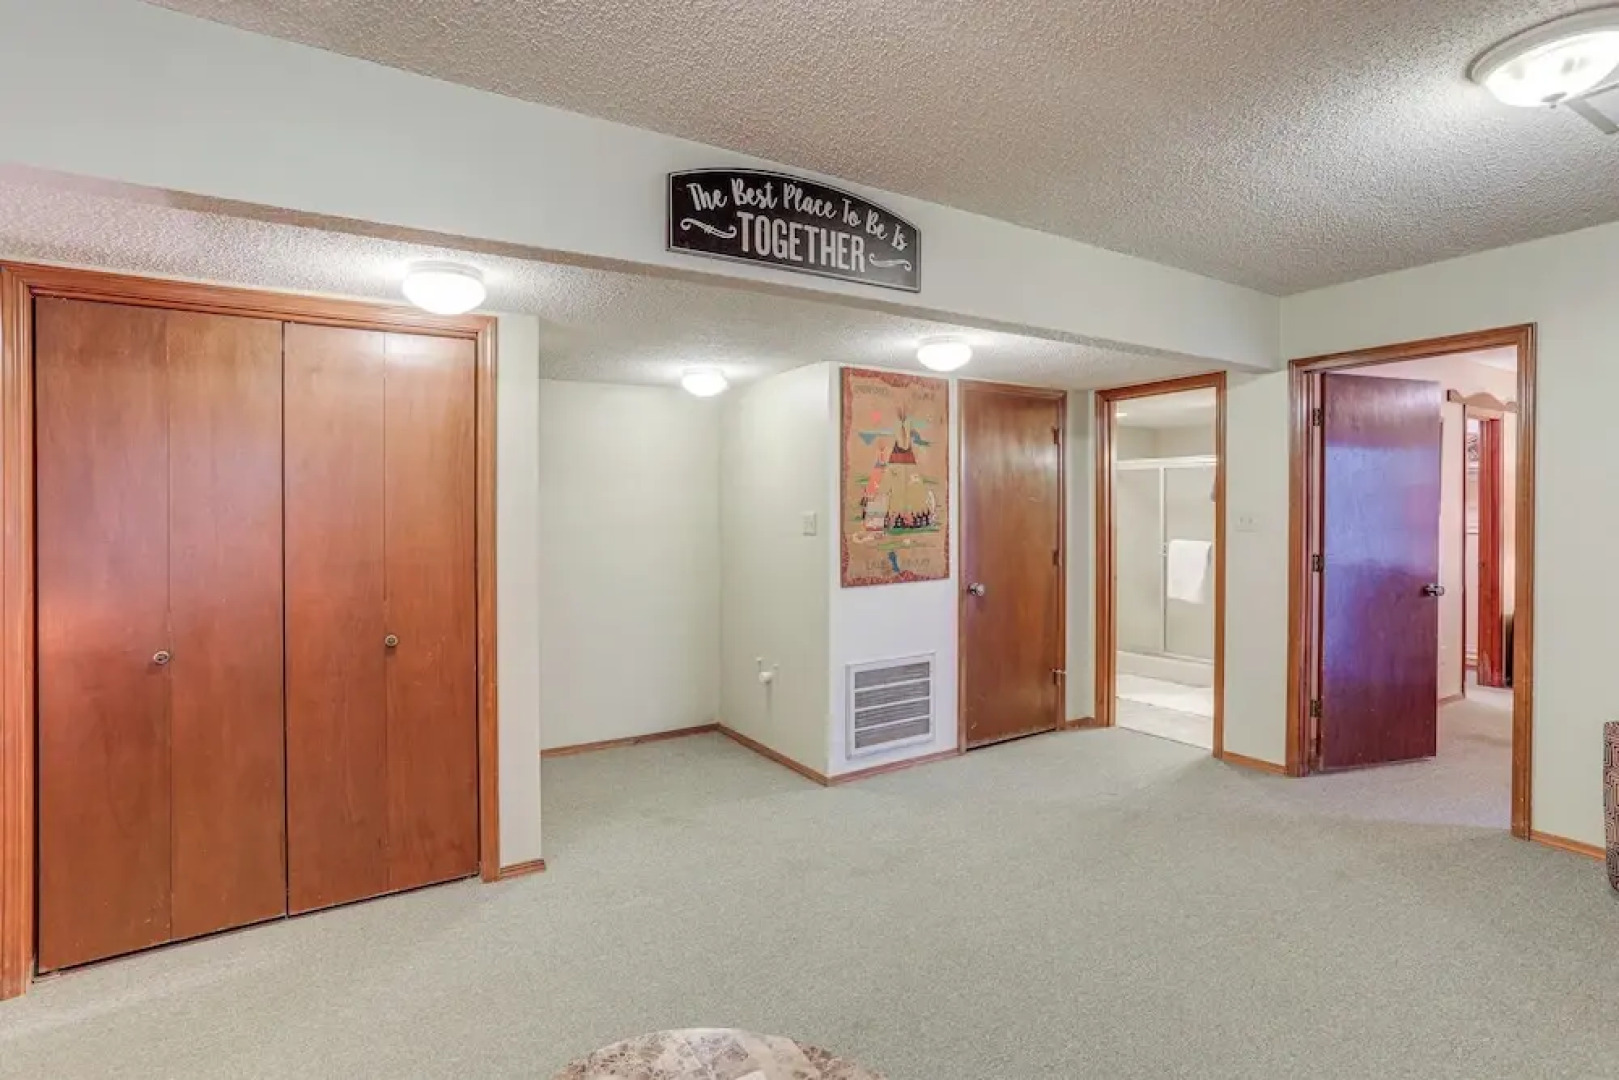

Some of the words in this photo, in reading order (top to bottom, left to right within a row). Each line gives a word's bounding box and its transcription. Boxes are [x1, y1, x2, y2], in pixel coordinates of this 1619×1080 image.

[687, 182, 728, 212] The
[731, 178, 777, 210] Best
[783, 183, 838, 219] Place
[841, 198, 862, 228] To
[865, 209, 888, 241] Be
[891, 225, 908, 252] Is
[737, 211, 866, 273] TOGETHER
